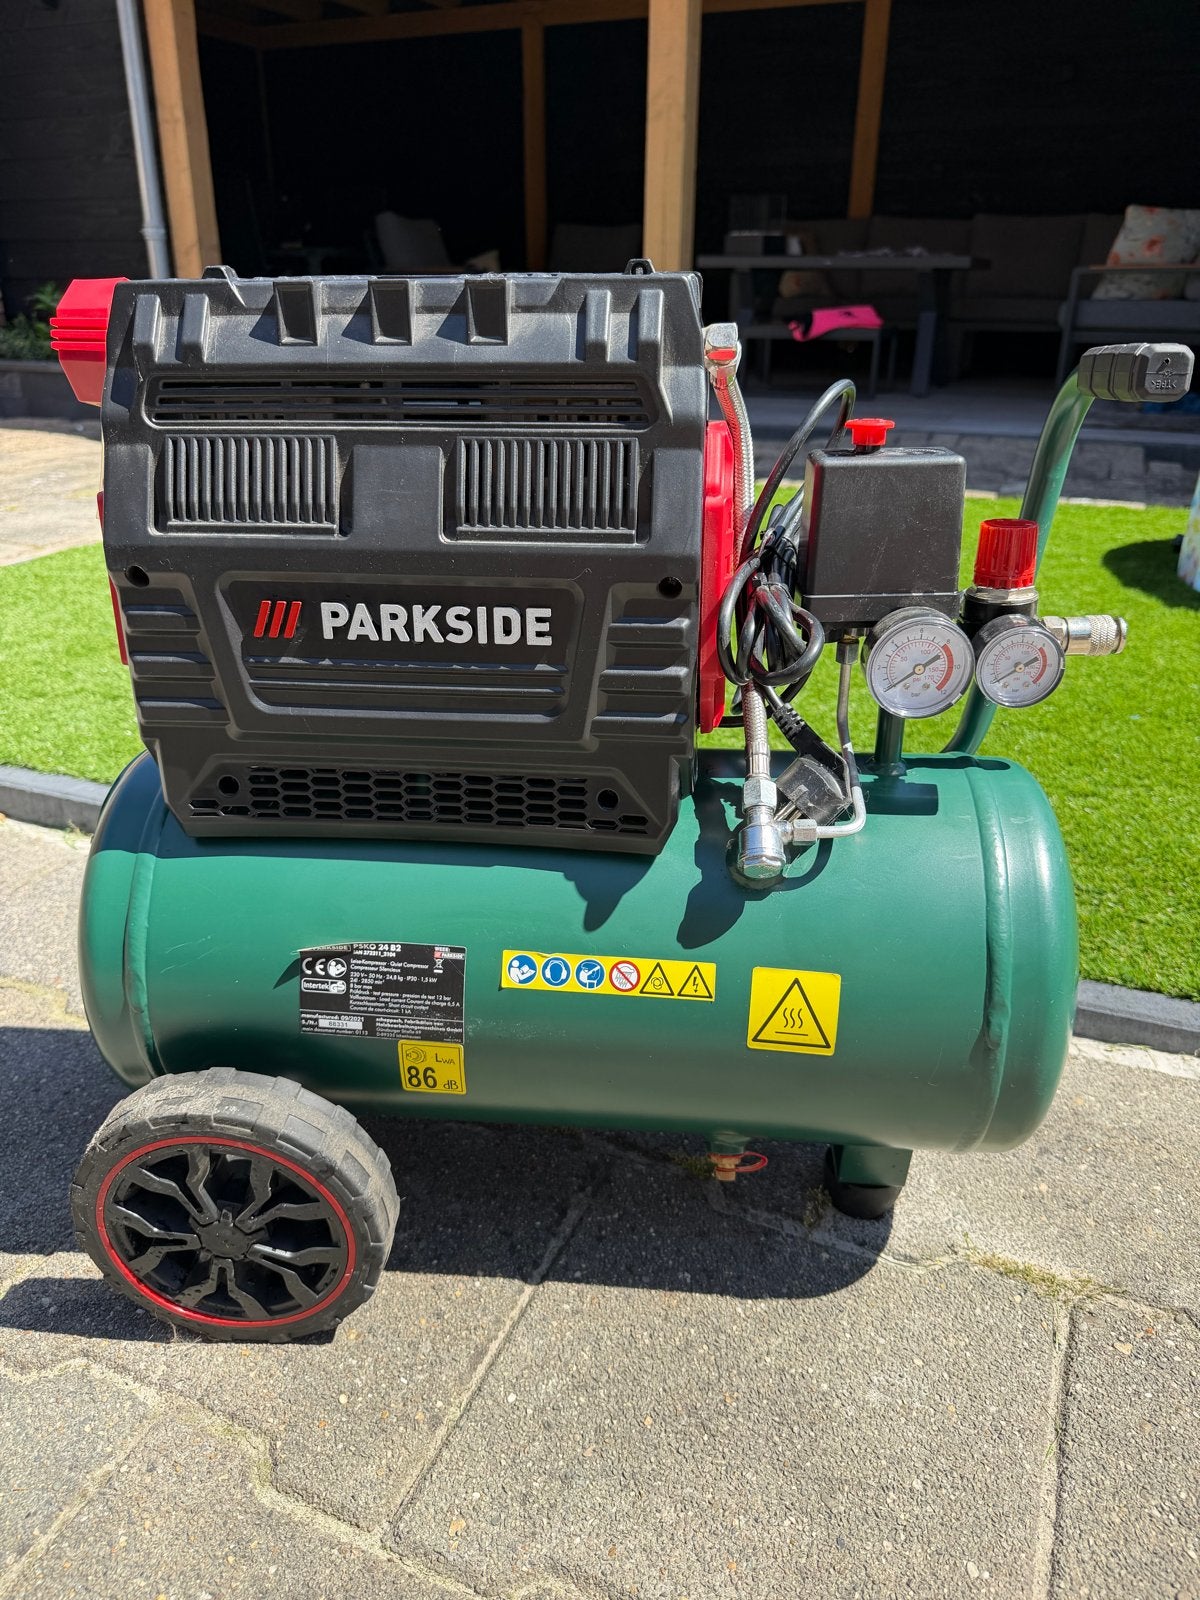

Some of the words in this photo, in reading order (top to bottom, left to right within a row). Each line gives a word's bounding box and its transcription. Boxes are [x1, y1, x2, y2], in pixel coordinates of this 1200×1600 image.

[320, 601, 553, 646] PARKSIDE
[402, 962, 429, 970] Compressor
[303, 981, 330, 991] Intertek
[407, 1065, 438, 1089] 86
[443, 1080, 459, 1090] dB
